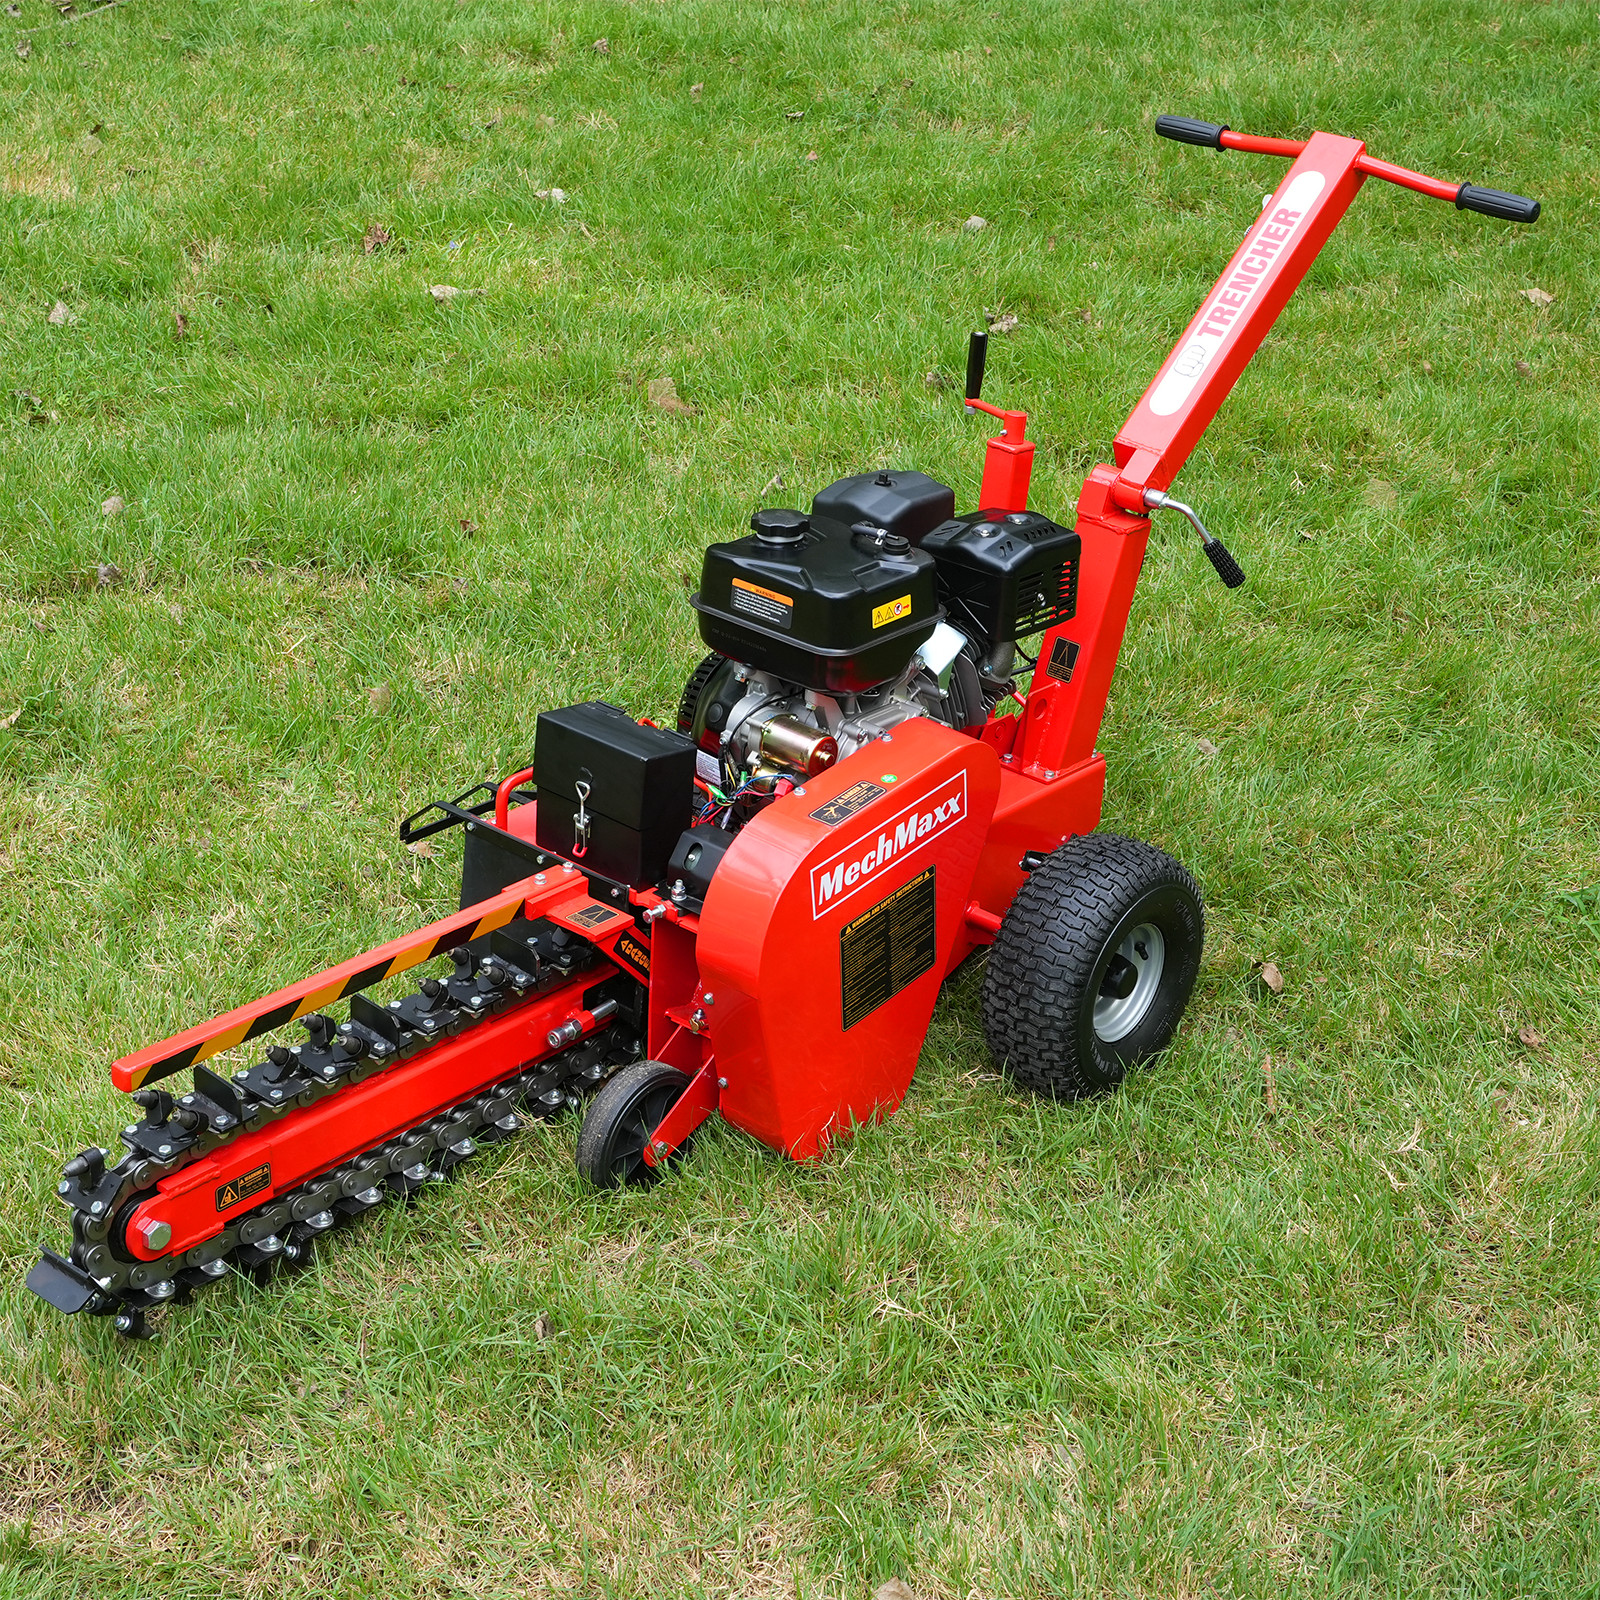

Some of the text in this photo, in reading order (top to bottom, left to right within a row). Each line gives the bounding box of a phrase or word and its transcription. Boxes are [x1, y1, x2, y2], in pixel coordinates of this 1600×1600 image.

[1197, 208, 1302, 338] TRENCHER
[818, 791, 962, 906] MechMaxx
[871, 905, 881, 916] AND
[880, 894, 896, 910] SAFETY
